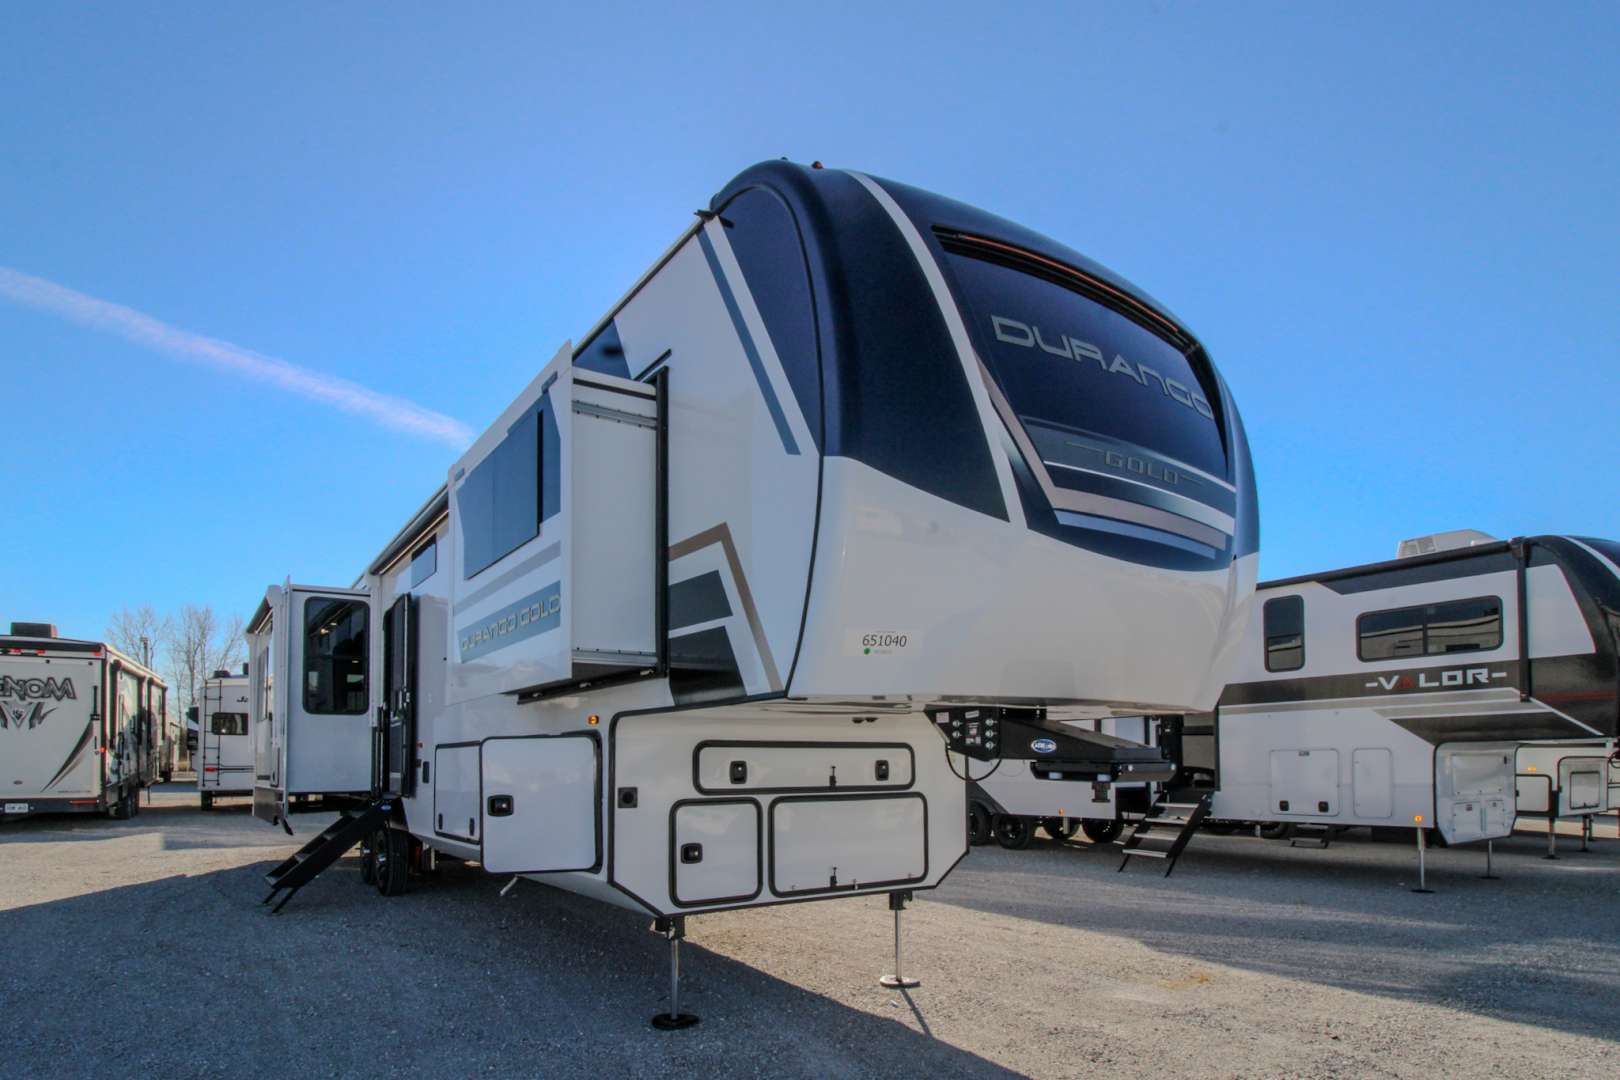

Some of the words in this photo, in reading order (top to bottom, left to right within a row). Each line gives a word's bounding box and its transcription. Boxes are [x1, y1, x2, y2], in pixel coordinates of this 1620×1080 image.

[1105, 450, 1178, 485] GOLD
[521, 595, 561, 625] GOLD
[862, 634, 908, 647] 651040
